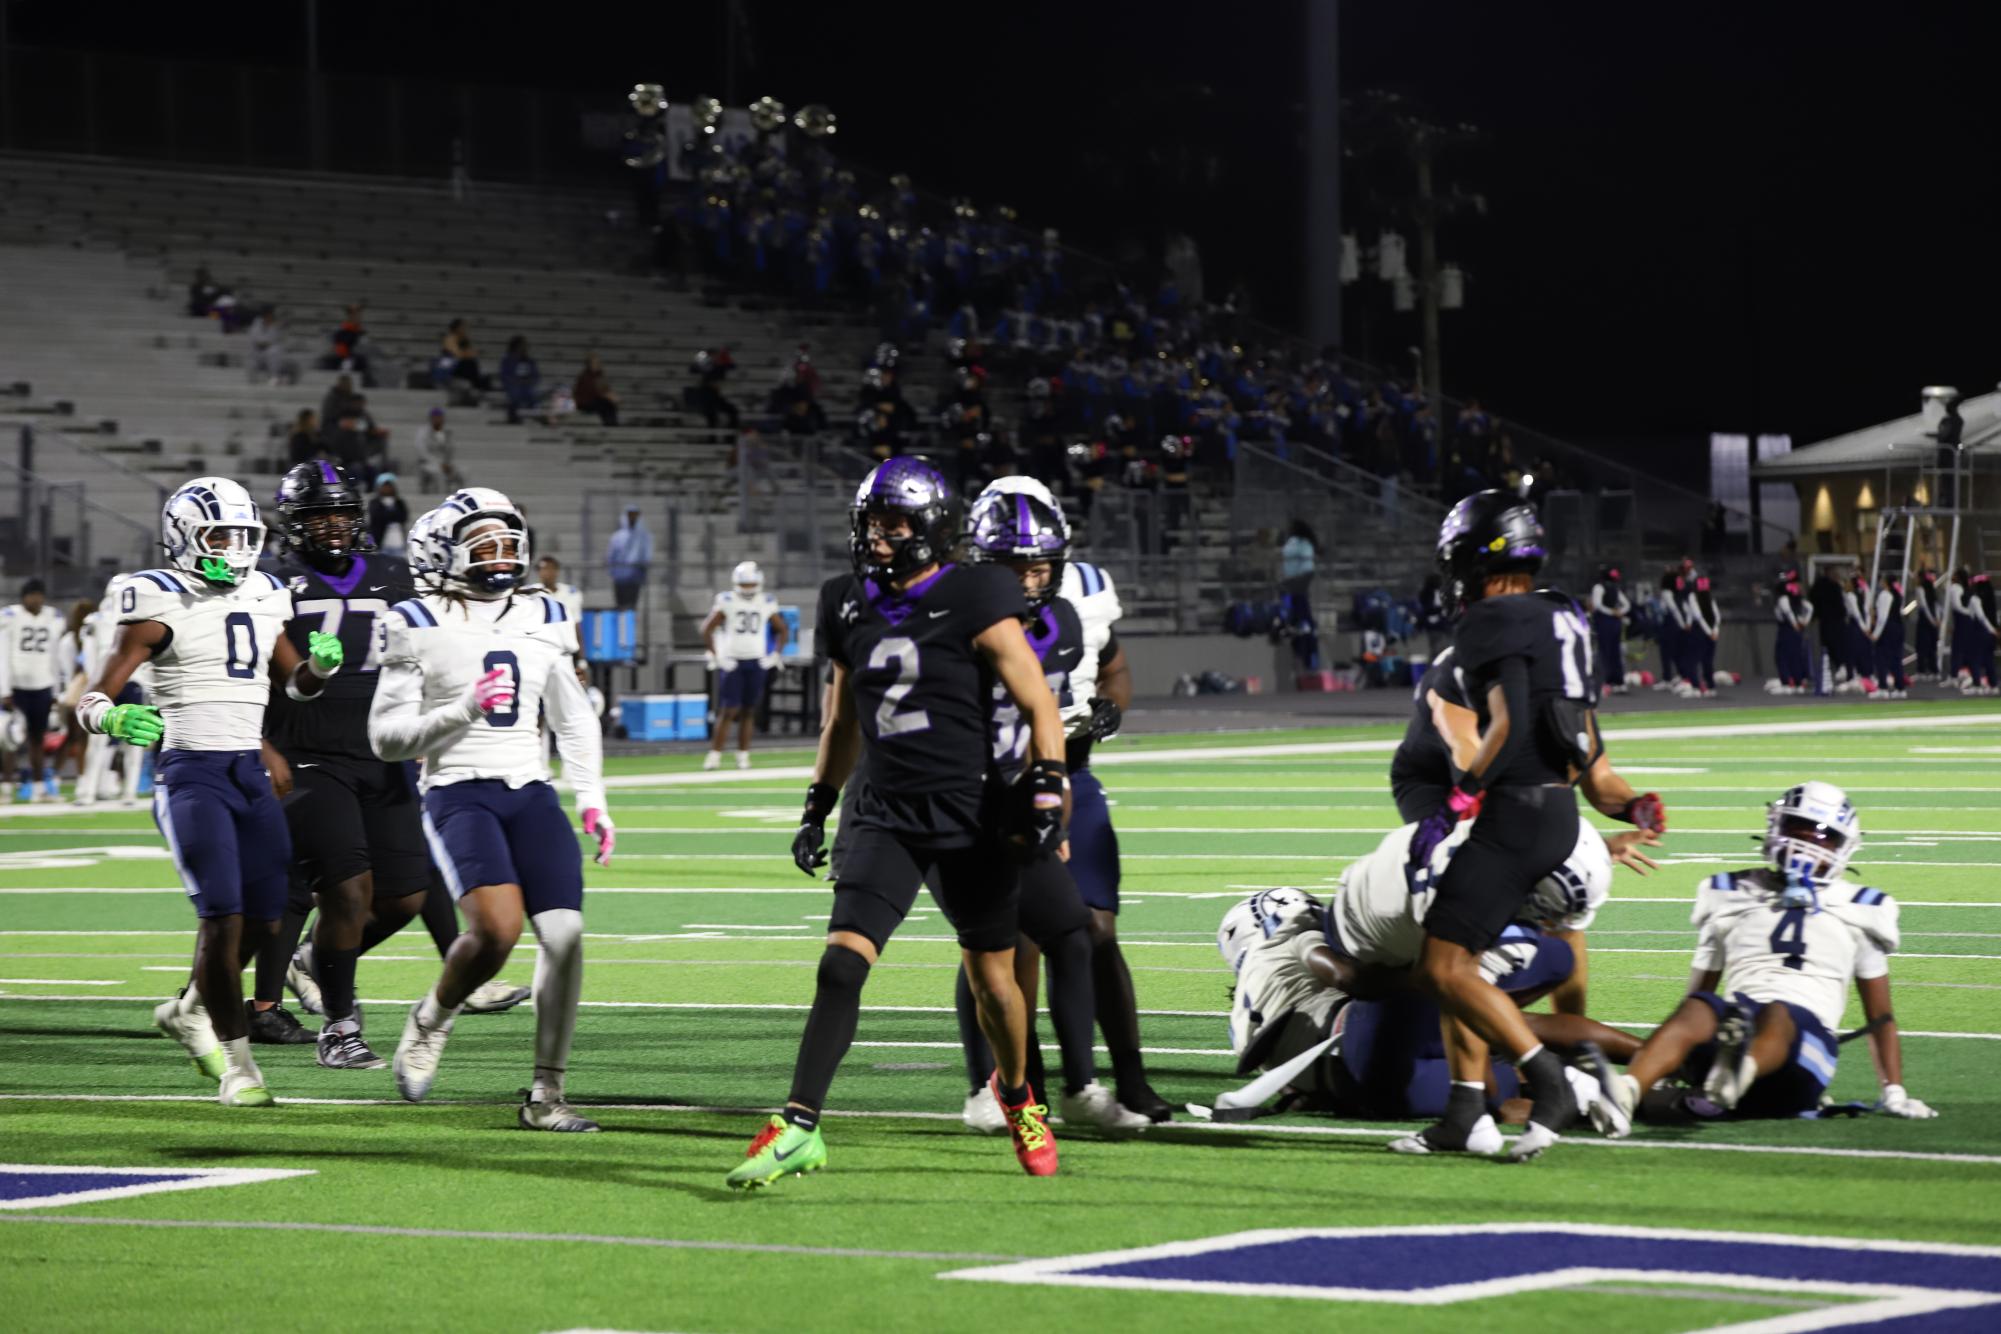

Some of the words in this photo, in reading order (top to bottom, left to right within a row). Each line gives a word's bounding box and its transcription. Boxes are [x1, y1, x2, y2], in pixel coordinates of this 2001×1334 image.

[122, 586, 136, 613] 0
[736, 610, 760, 634] 30
[20, 626, 48, 652] 22
[226, 612, 258, 679] 0
[295, 597, 389, 671] 77
[868, 636, 931, 738] 2
[1770, 907, 1807, 971] 4
